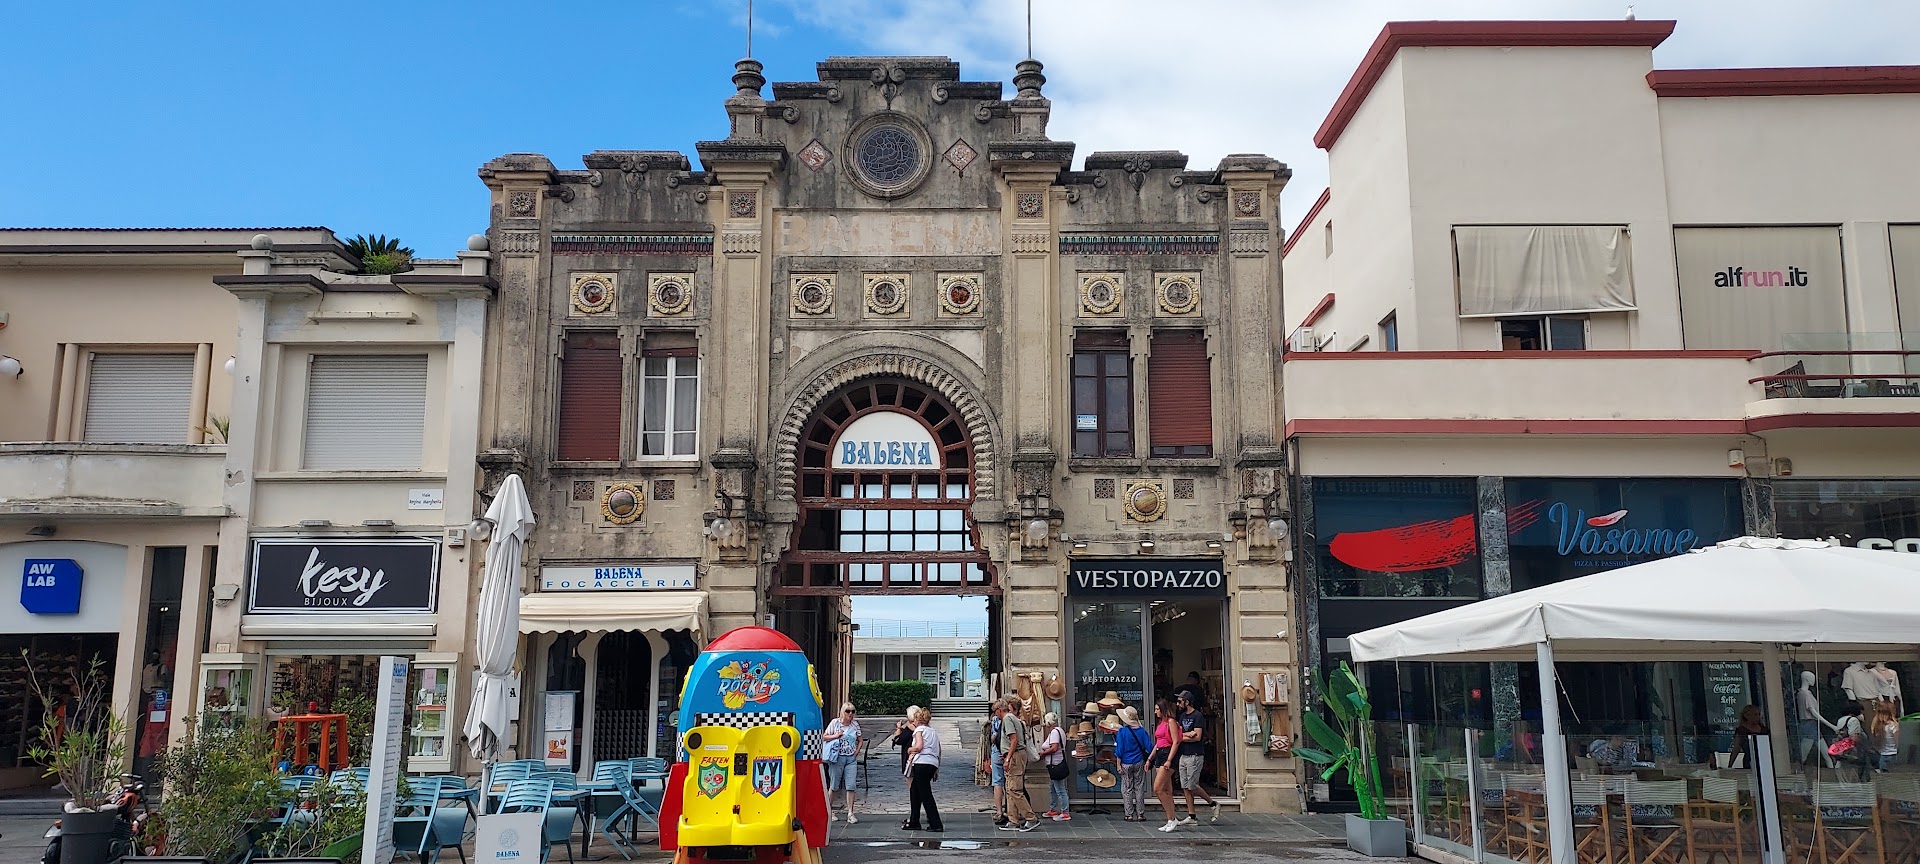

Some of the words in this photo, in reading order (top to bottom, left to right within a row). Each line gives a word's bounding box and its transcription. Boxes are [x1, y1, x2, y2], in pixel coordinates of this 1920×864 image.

[1714, 266, 1808, 287] alfrun.it
[841, 440, 933, 465] BALENA
[1548, 502, 1699, 556] Vasame
[29, 564, 55, 574] AW
[595, 568, 643, 579] BALENA
[27, 576, 56, 587] LAB
[546, 579, 692, 588] FOCACCERIA
[1075, 570, 1221, 588] VESTOPAZZO
[304, 597, 349, 607] BIJOUX
[716, 679, 780, 696] ROCKET
[1720, 695, 1737, 705] Leffe
[701, 756, 729, 764] FASTEN
[496, 850, 520, 858] BALENA
